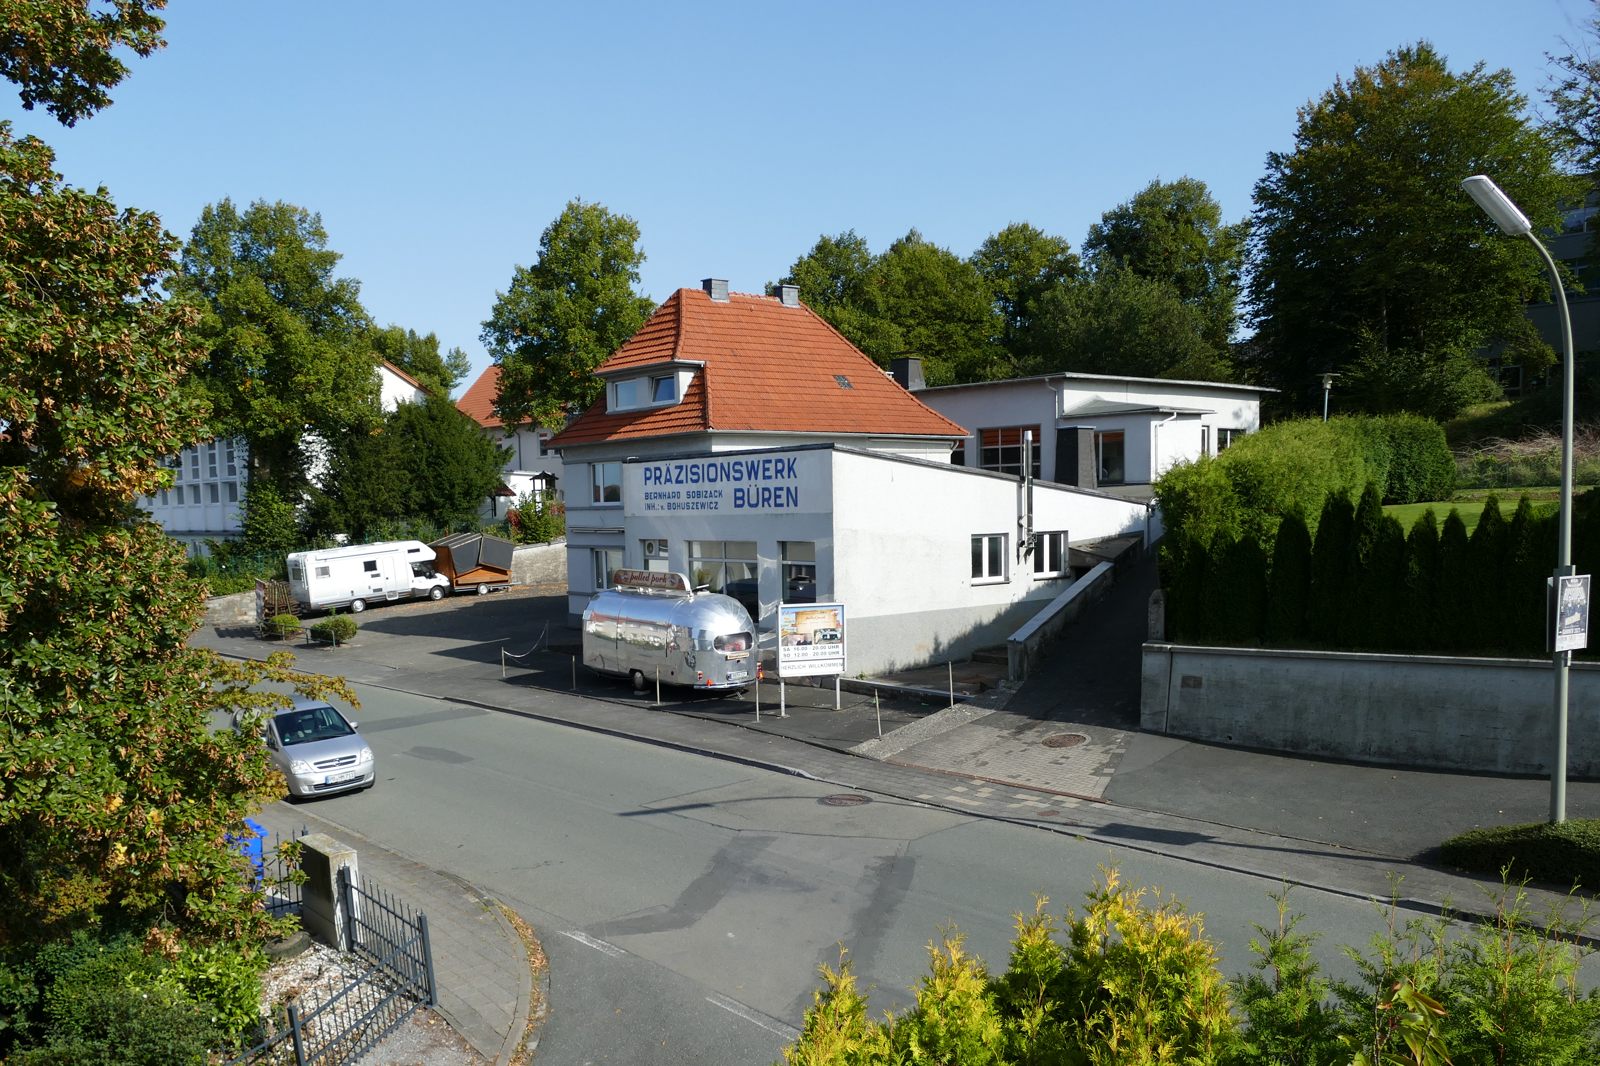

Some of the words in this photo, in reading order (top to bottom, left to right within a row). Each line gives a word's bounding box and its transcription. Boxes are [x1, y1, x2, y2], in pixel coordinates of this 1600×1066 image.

[644, 457, 797, 485] PRÄZISIONSWERK
[644, 491, 681, 500] BERNHARD
[686, 489, 723, 499] SOBIZACK
[734, 484, 798, 508] BÜREN
[667, 501, 719, 511] BOHUSZEWICZ
[629, 571, 650, 583] pulled
